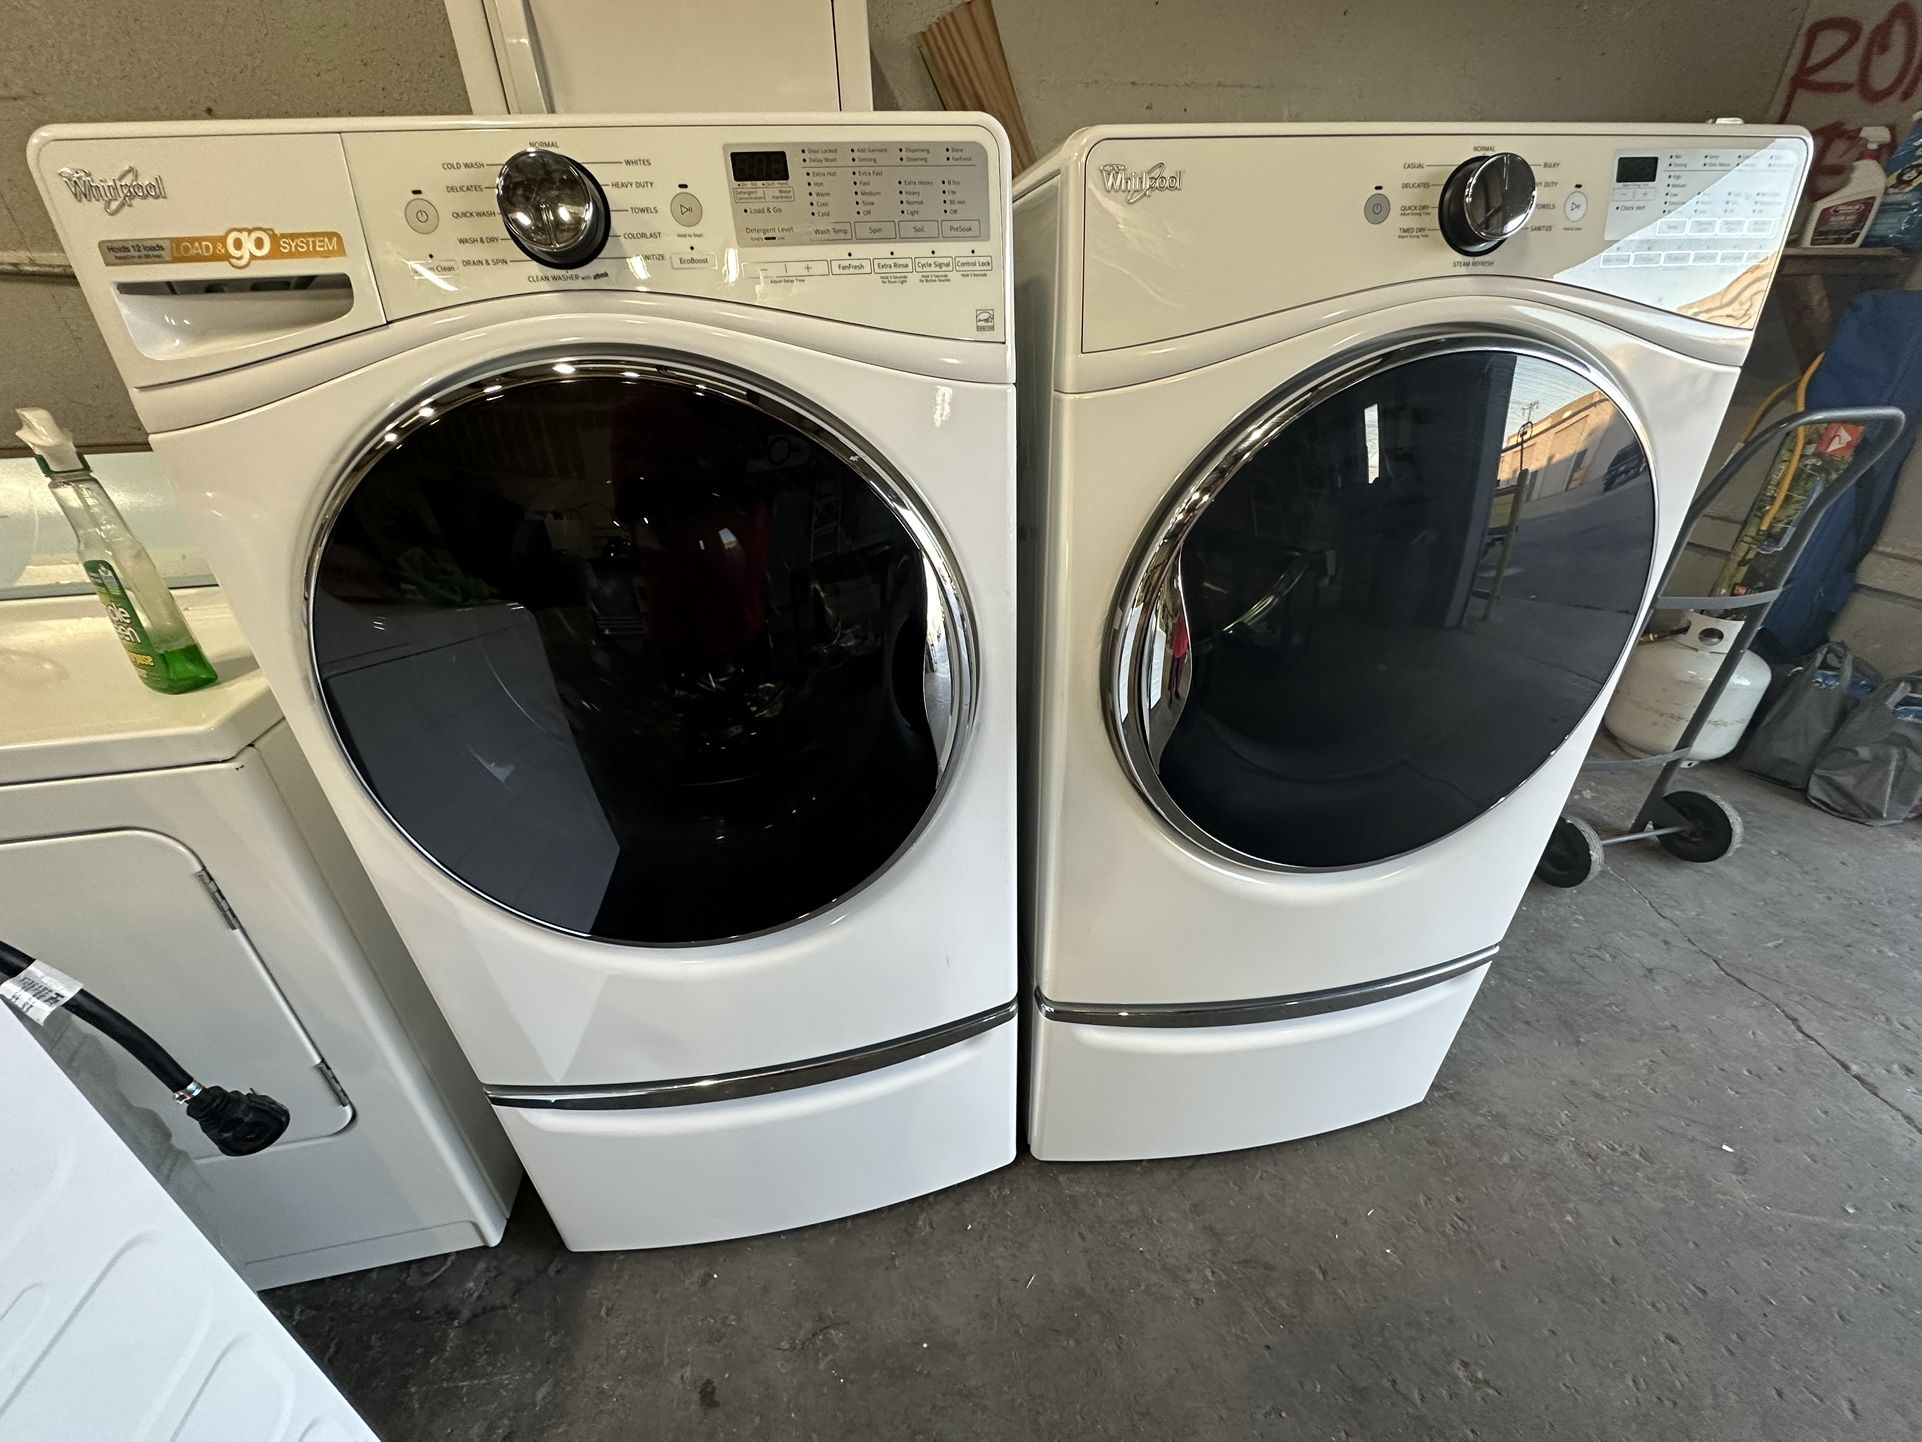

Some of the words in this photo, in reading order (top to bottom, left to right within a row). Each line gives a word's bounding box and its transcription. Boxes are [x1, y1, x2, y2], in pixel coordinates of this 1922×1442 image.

[529, 141, 560, 149] NORMAL
[446, 184, 483, 193] DELICATES
[635, 181, 654, 189] DUTY
[1100, 163, 1183, 205] Whirlpool
[58, 167, 168, 215] Whirlpool
[745, 227, 776, 235] Detergent
[832, 227, 848, 236] Temp
[869, 226, 882, 235] Spin
[949, 225, 972, 233] PreSoak
[623, 232, 662, 240] COLORLAST
[106, 245, 131, 254] Holds
[142, 244, 165, 252] loads
[172, 241, 213, 257] LOAD
[216, 244, 225, 254] &
[226, 229, 272, 268] go
[279, 237, 338, 253] SYSTEM
[679, 257, 709, 265] EcoBoost
[877, 262, 892, 270] Extra
[892, 261, 909, 269] Rinse
[917, 261, 931, 270] Cycle
[931, 260, 951, 270] Signal
[956, 260, 975, 268] Control
[976, 259, 991, 267] Lock
[1471, 260, 1495, 268] REFRESH
[436, 265, 456, 273] Clean
[838, 263, 865, 271] FanFresh
[528, 275, 551, 283] CLEAN
[552, 274, 580, 282] WASHER
